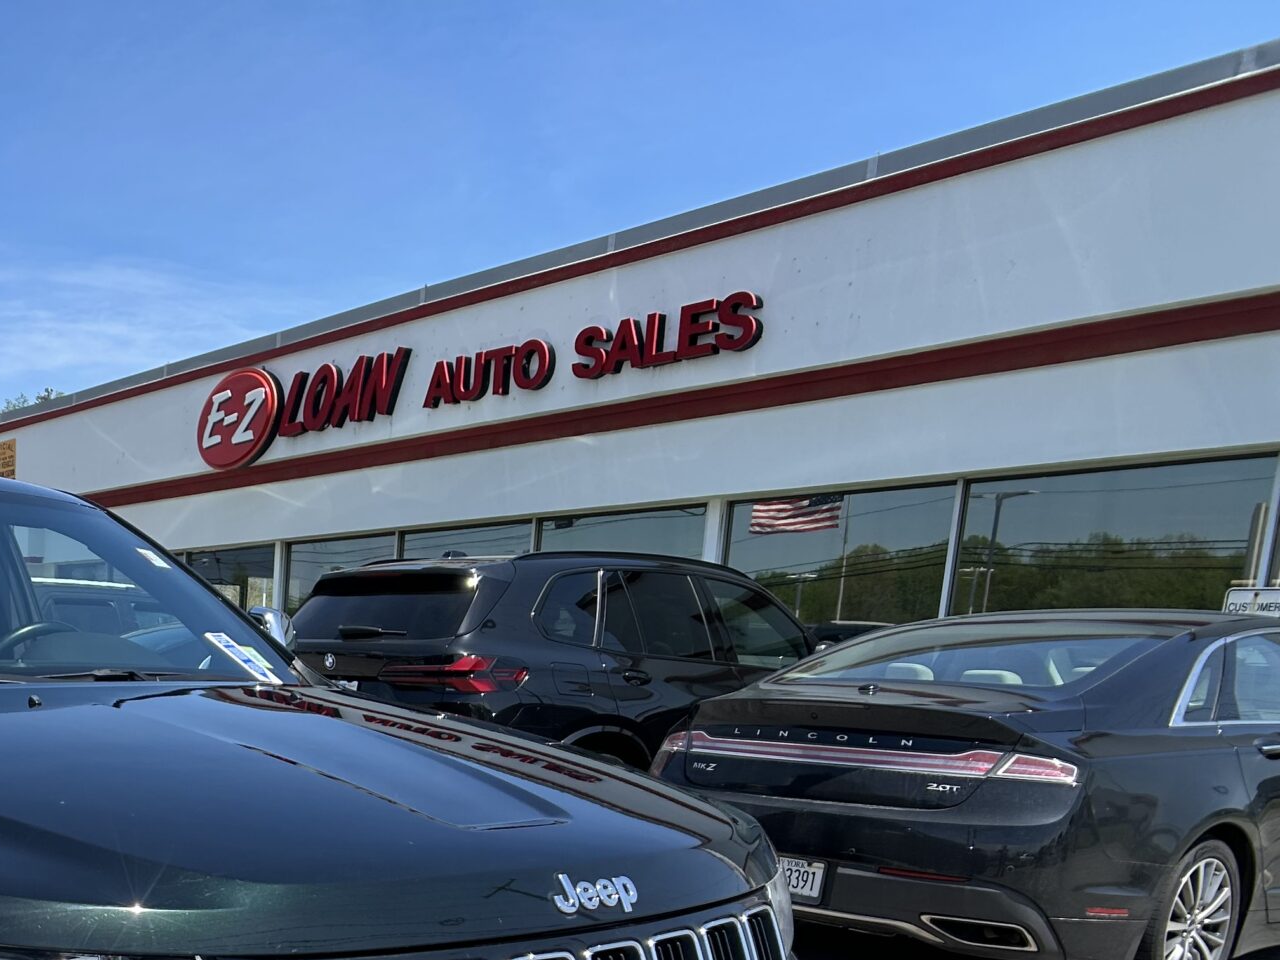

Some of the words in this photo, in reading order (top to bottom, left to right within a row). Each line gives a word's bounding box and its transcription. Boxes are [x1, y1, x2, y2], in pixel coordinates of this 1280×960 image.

[201, 387, 267, 449] E-Z
[276, 346, 413, 438] LOAN
[422, 338, 557, 409] AUTO
[571, 290, 764, 380] SALES
[1227, 602, 1280, 613] CUSOMER
[734, 727, 913, 747] LINCOLN
[786, 859, 806, 869] YORK
[553, 873, 638, 914] Jeep
